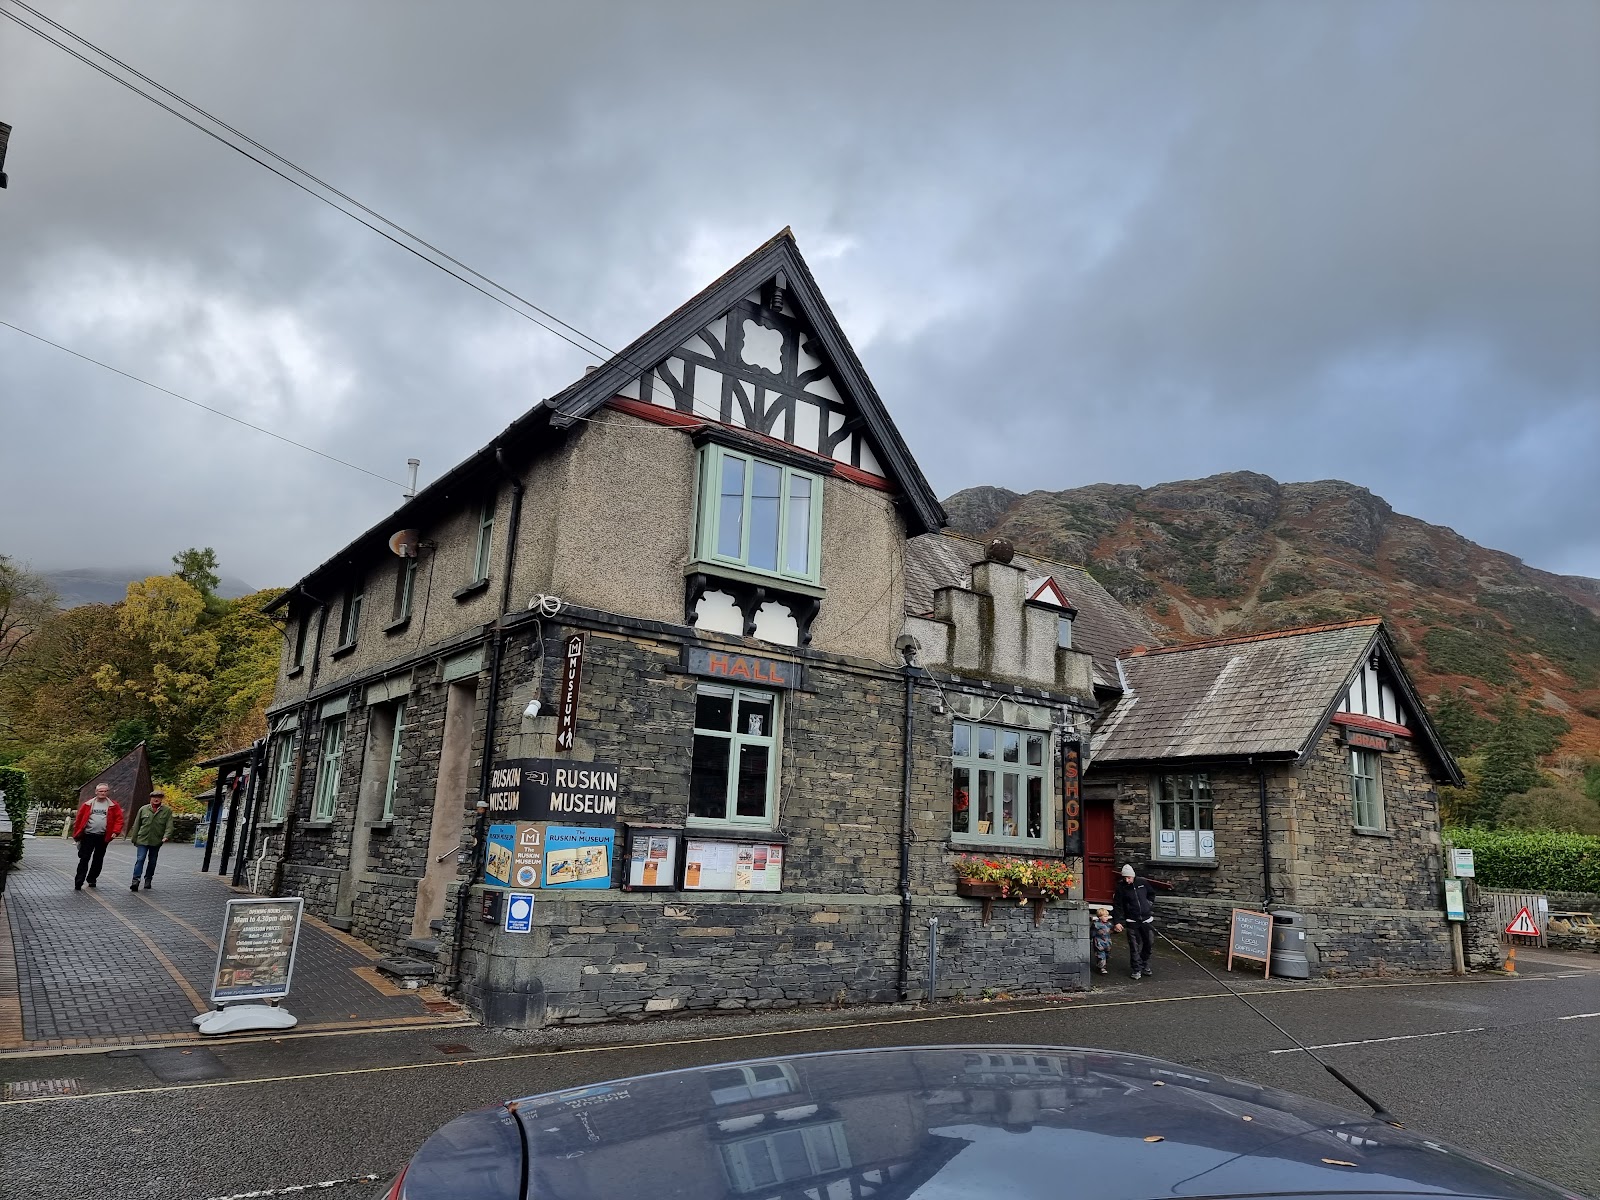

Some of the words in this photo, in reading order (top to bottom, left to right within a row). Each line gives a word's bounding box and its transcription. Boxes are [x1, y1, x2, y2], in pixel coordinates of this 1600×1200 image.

[709, 653, 784, 683] HALL
[564, 657, 578, 726] MUSEUM
[1349, 733, 1388, 750] LIBRARY
[492, 768, 521, 788] RUSKIN
[555, 768, 618, 792] RUSKIN
[490, 791, 519, 811] MUSEUM
[550, 792, 617, 815] MUSEUM
[1066, 762, 1079, 836] SHOP
[549, 834, 577, 842] RUSKIN
[233, 916, 249, 924] 10am
[256, 915, 278, 923] 4.30pm
[279, 914, 294, 922] daily
